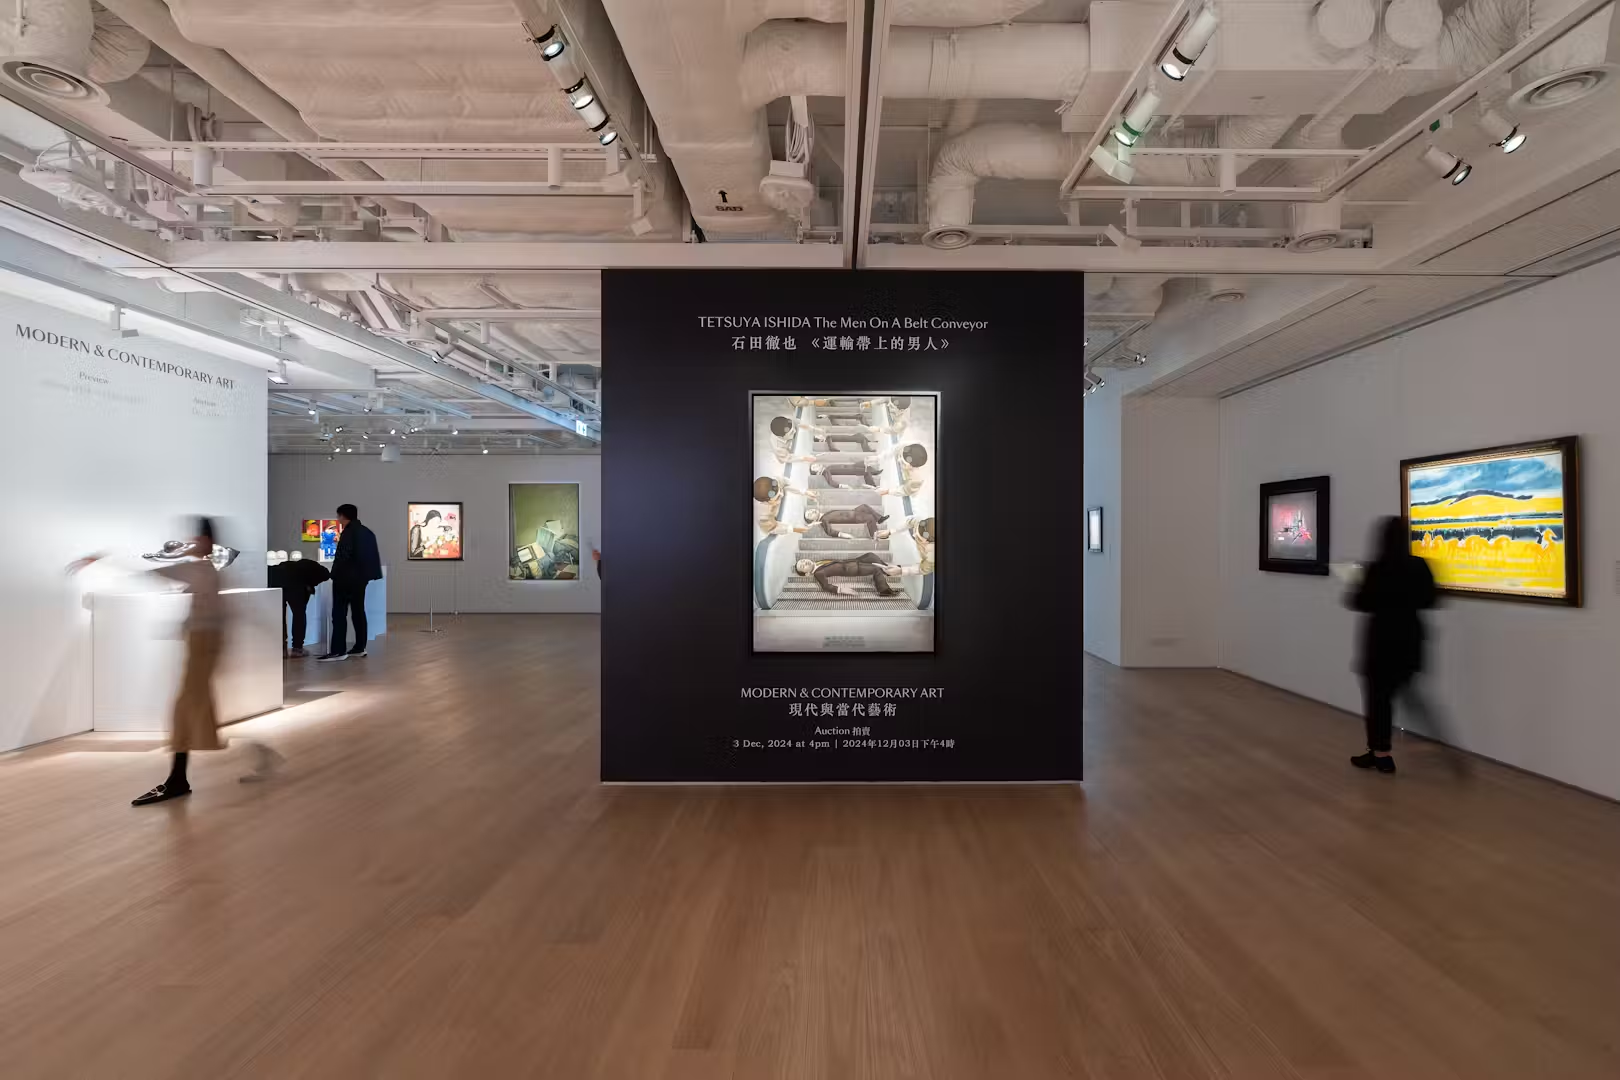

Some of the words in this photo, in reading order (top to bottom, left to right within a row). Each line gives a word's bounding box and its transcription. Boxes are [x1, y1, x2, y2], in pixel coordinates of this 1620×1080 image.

[697, 316, 761, 328] TETSUYA
[764, 316, 812, 328] ISHIDA
[813, 316, 837, 329] The
[840, 316, 867, 329] Men
[869, 317, 889, 329] On
[891, 317, 902, 329] A
[904, 317, 929, 329] Belt
[930, 317, 989, 332] Conveyor
[731, 335, 797, 351] 石田徹也
[15, 323, 91, 354] MODERN
[94, 344, 105, 358] &
[107, 348, 214, 385] CONTEMPORARY
[215, 375, 237, 390] ART
[740, 687, 797, 699] MODERN
[799, 687, 810, 699] &
[811, 687, 918, 699] CONTEMPORARY
[919, 687, 945, 699] ART
[788, 702, 897, 717] 現代與當代藝術
[814, 726, 851, 736] Auction
[733, 739, 740, 748] 3
[767, 739, 792, 748] 2024
[795, 740, 806, 748] at
[808, 739, 830, 750] 4pm
